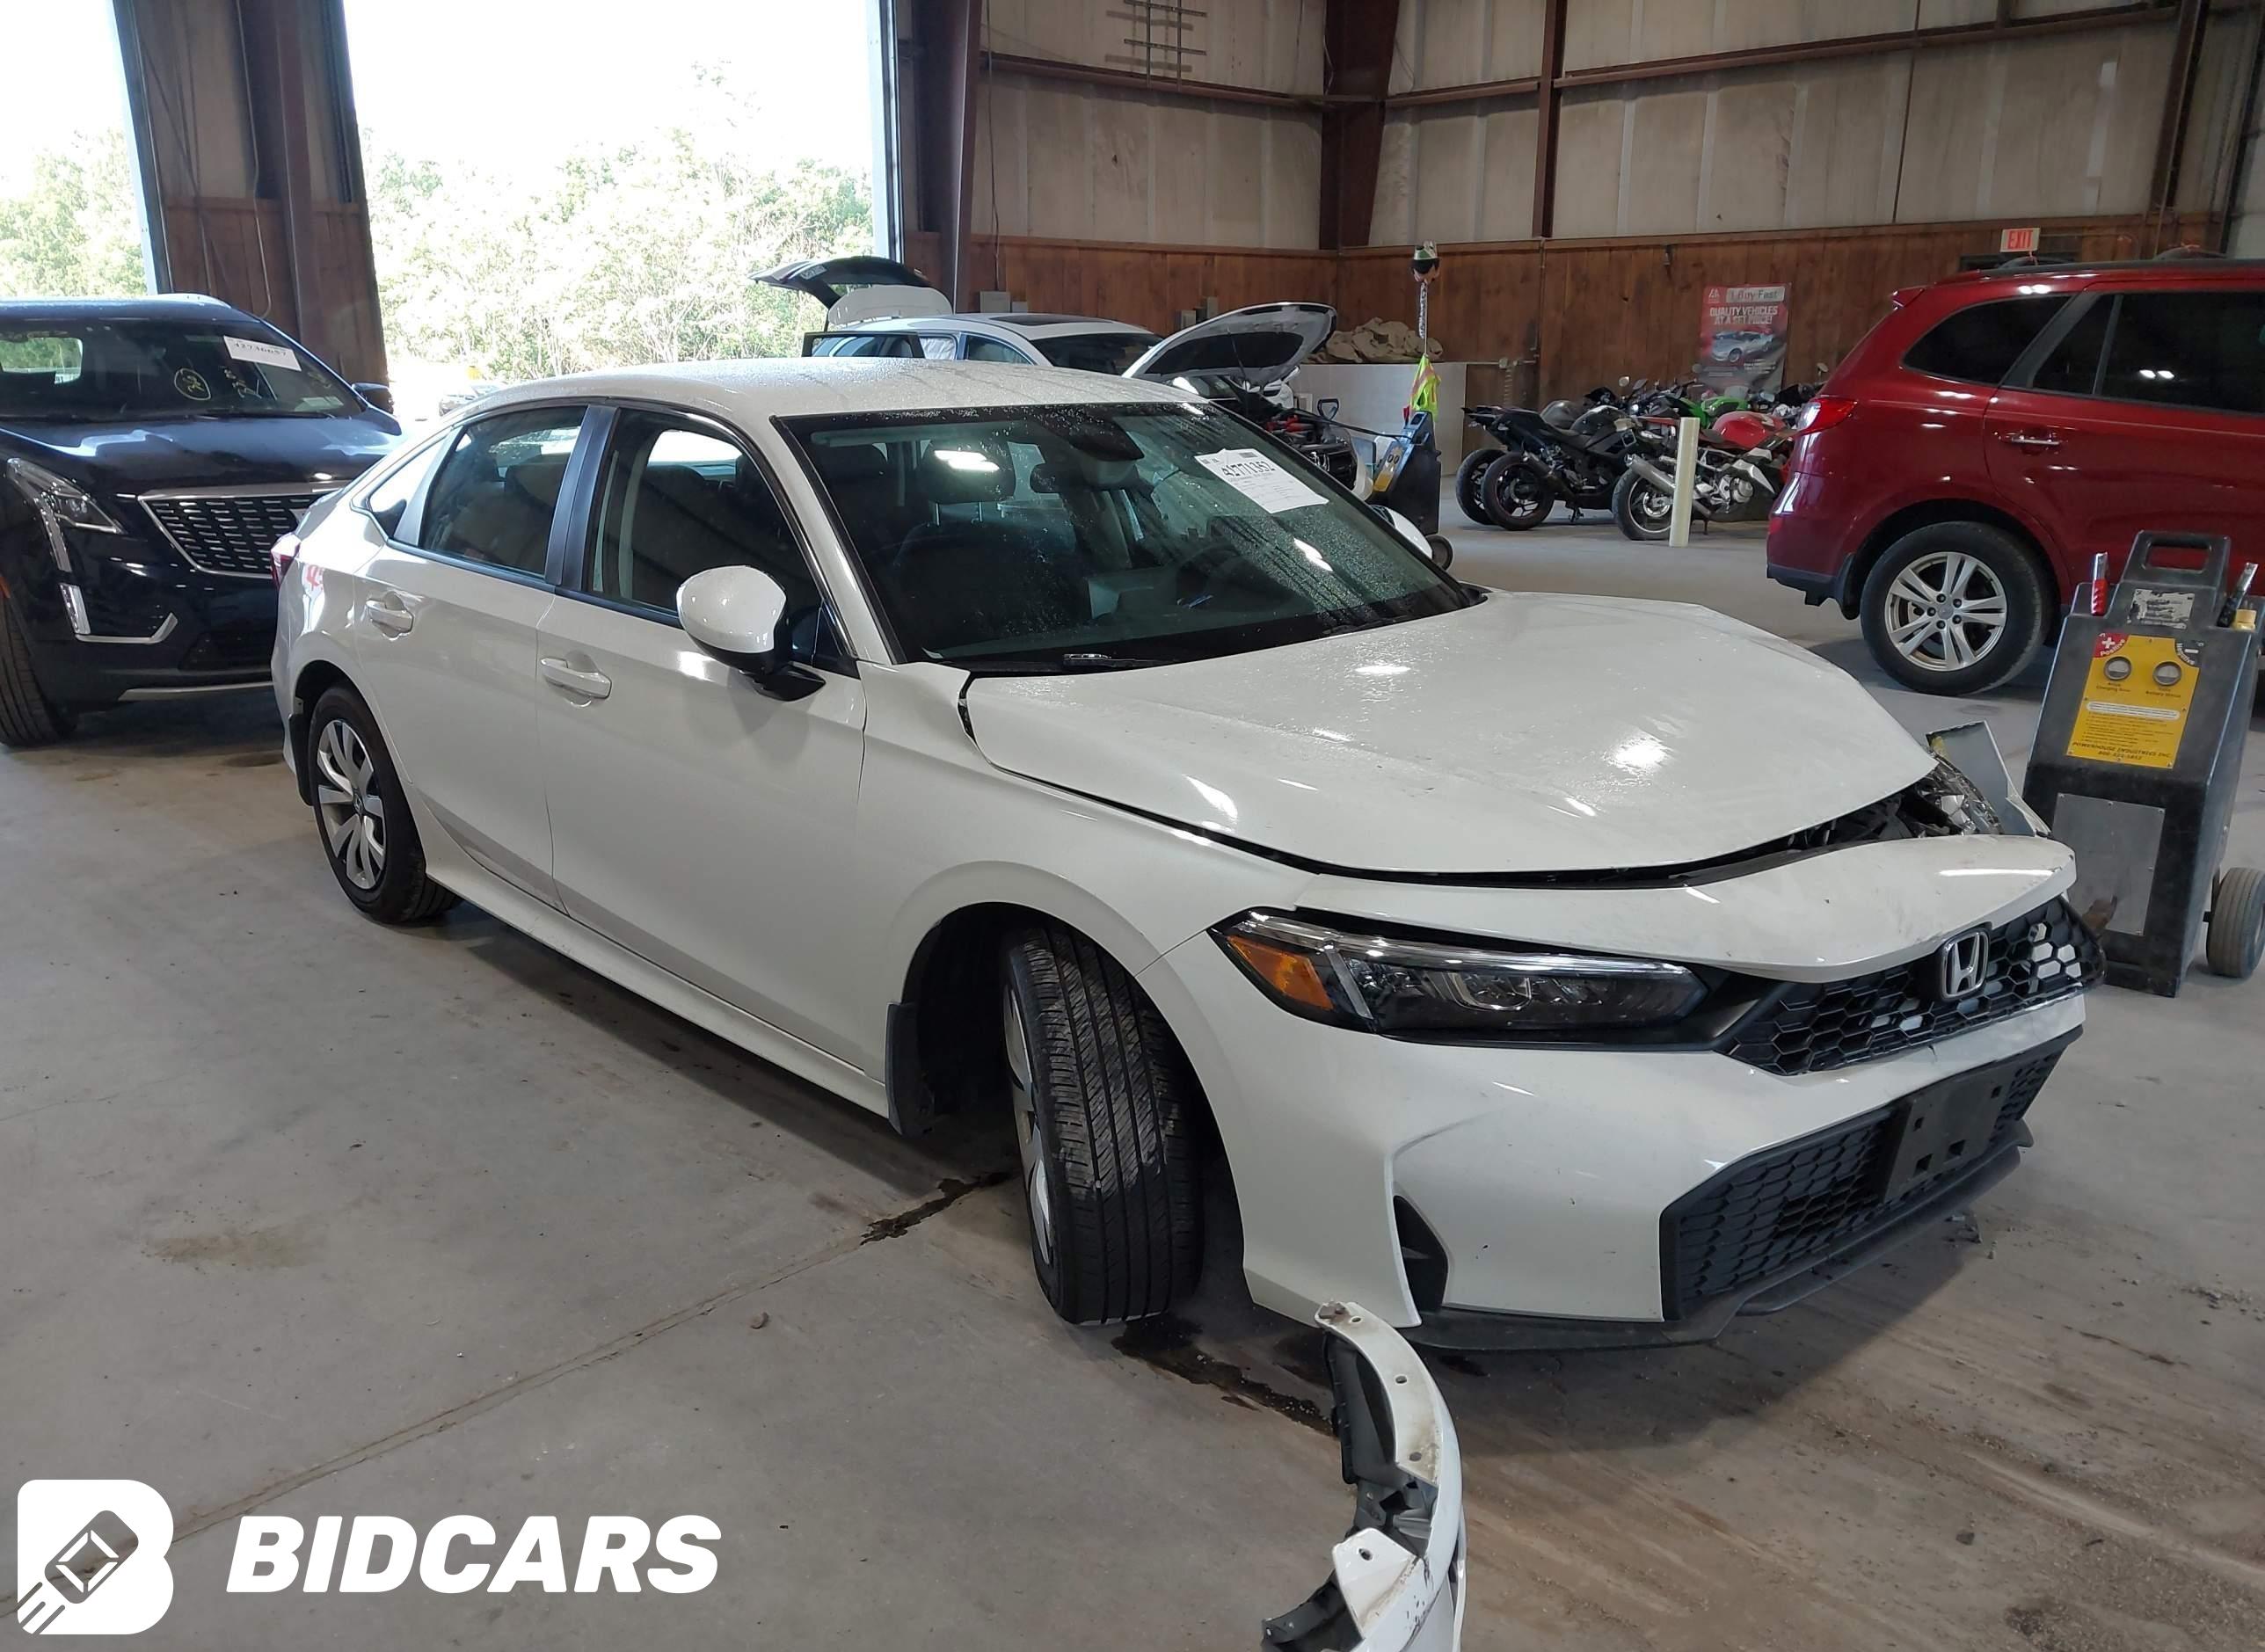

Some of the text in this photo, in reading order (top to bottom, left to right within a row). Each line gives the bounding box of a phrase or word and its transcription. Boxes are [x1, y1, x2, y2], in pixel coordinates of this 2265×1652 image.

[2007, 229, 2034, 250] EXIT
[1710, 305, 1779, 317] QUALITY VEHICLES
[1221, 461, 1276, 477] 42771352
[2100, 638, 2125, 656] Positive
